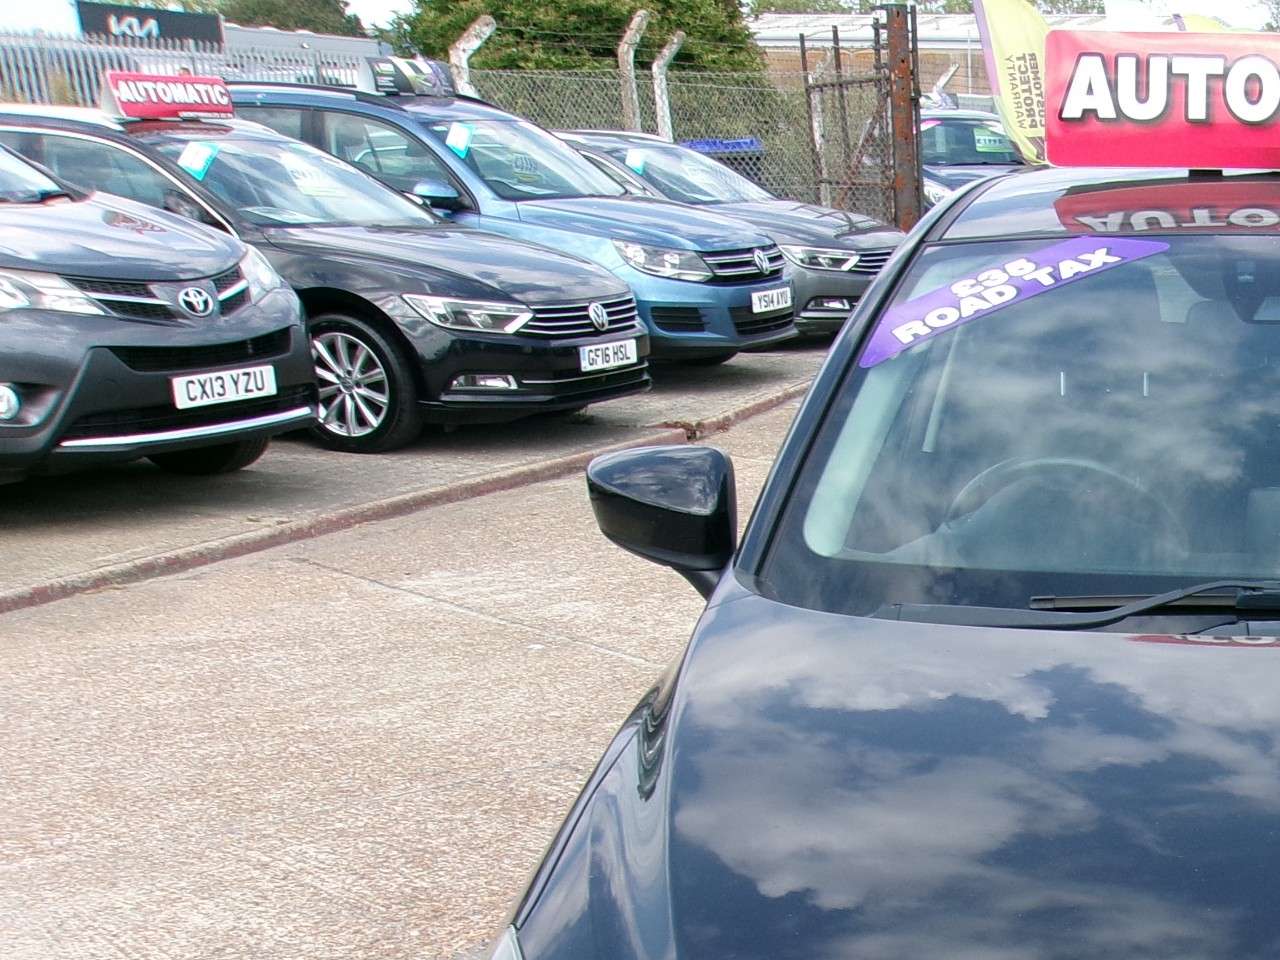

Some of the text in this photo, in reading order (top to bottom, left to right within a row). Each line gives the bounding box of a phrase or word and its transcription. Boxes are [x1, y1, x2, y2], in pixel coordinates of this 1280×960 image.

[117, 80, 230, 104] AUTOMATIC
[950, 257, 1038, 299] £35
[891, 247, 1122, 344] ROAD TAX
[587, 343, 631, 366] GF16 HSL
[186, 369, 265, 401] CX13 YZU
